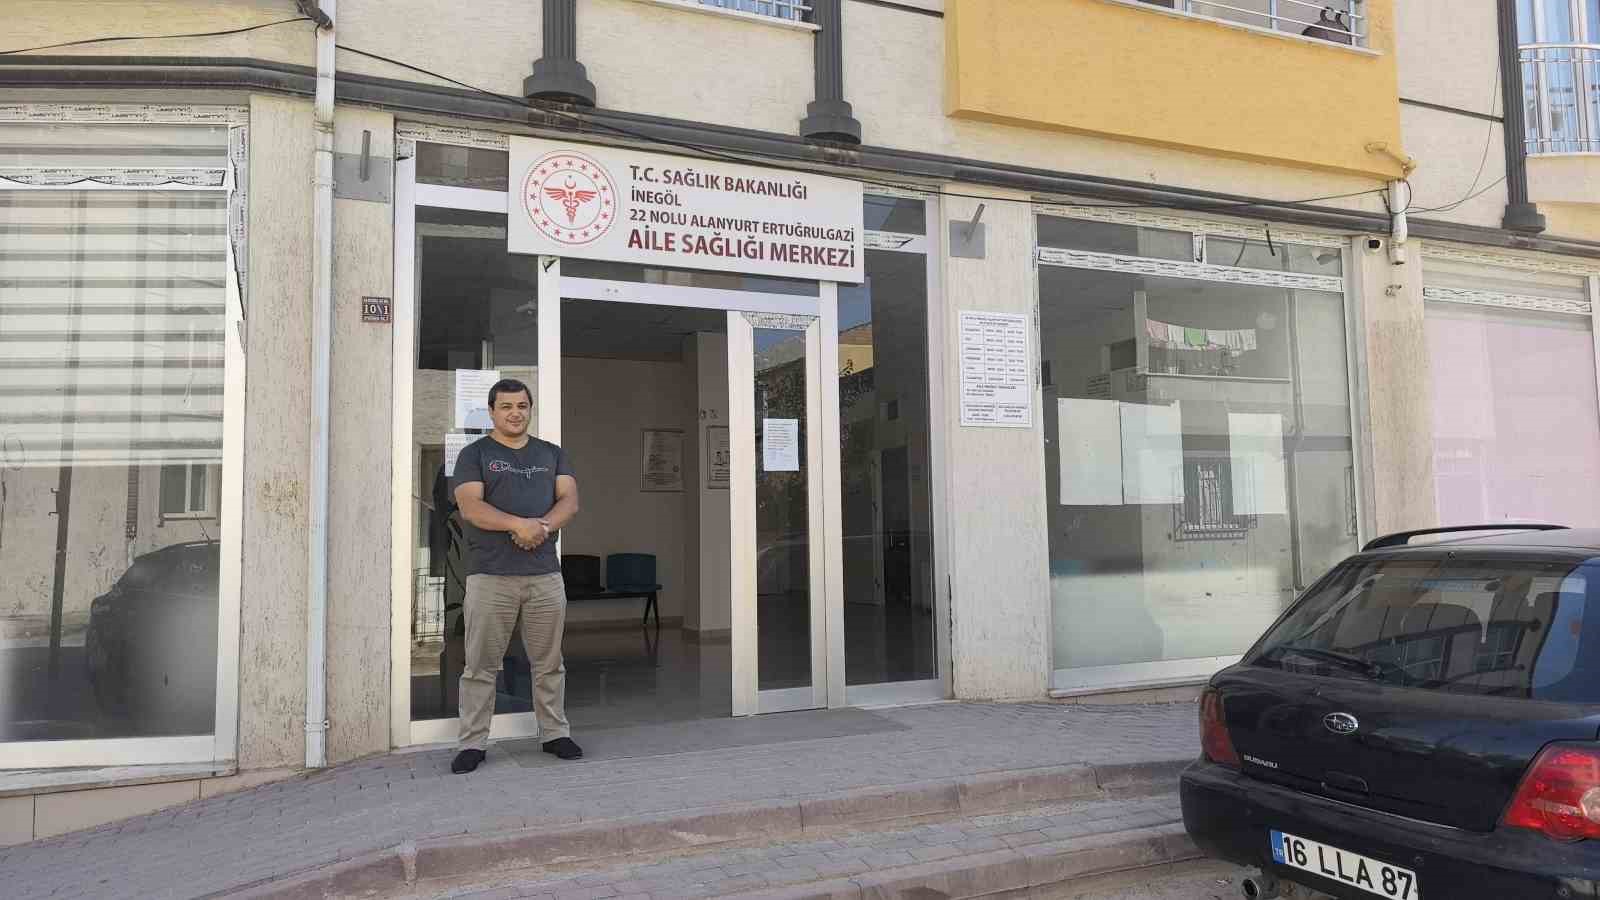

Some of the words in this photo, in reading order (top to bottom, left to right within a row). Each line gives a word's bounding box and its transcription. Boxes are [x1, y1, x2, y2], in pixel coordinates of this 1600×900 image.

[629, 165, 658, 183] T.C.
[663, 168, 721, 190] SAĞLIK
[724, 176, 807, 200] BAKANLIĞI
[631, 185, 682, 207] İNEGÖL
[630, 209, 646, 221] 22
[650, 210, 687, 226] NOLU
[690, 215, 759, 233] ALANYURT
[762, 222, 854, 242] ERTUĞRULGAZİ
[628, 224, 676, 252] AİLE
[682, 231, 764, 260] SAĞLIĞI
[770, 244, 855, 268] MERKEZİ
[1284, 836, 1307, 867] 16
[1318, 846, 1374, 889] LLA
[1381, 866, 1412, 900] 87
